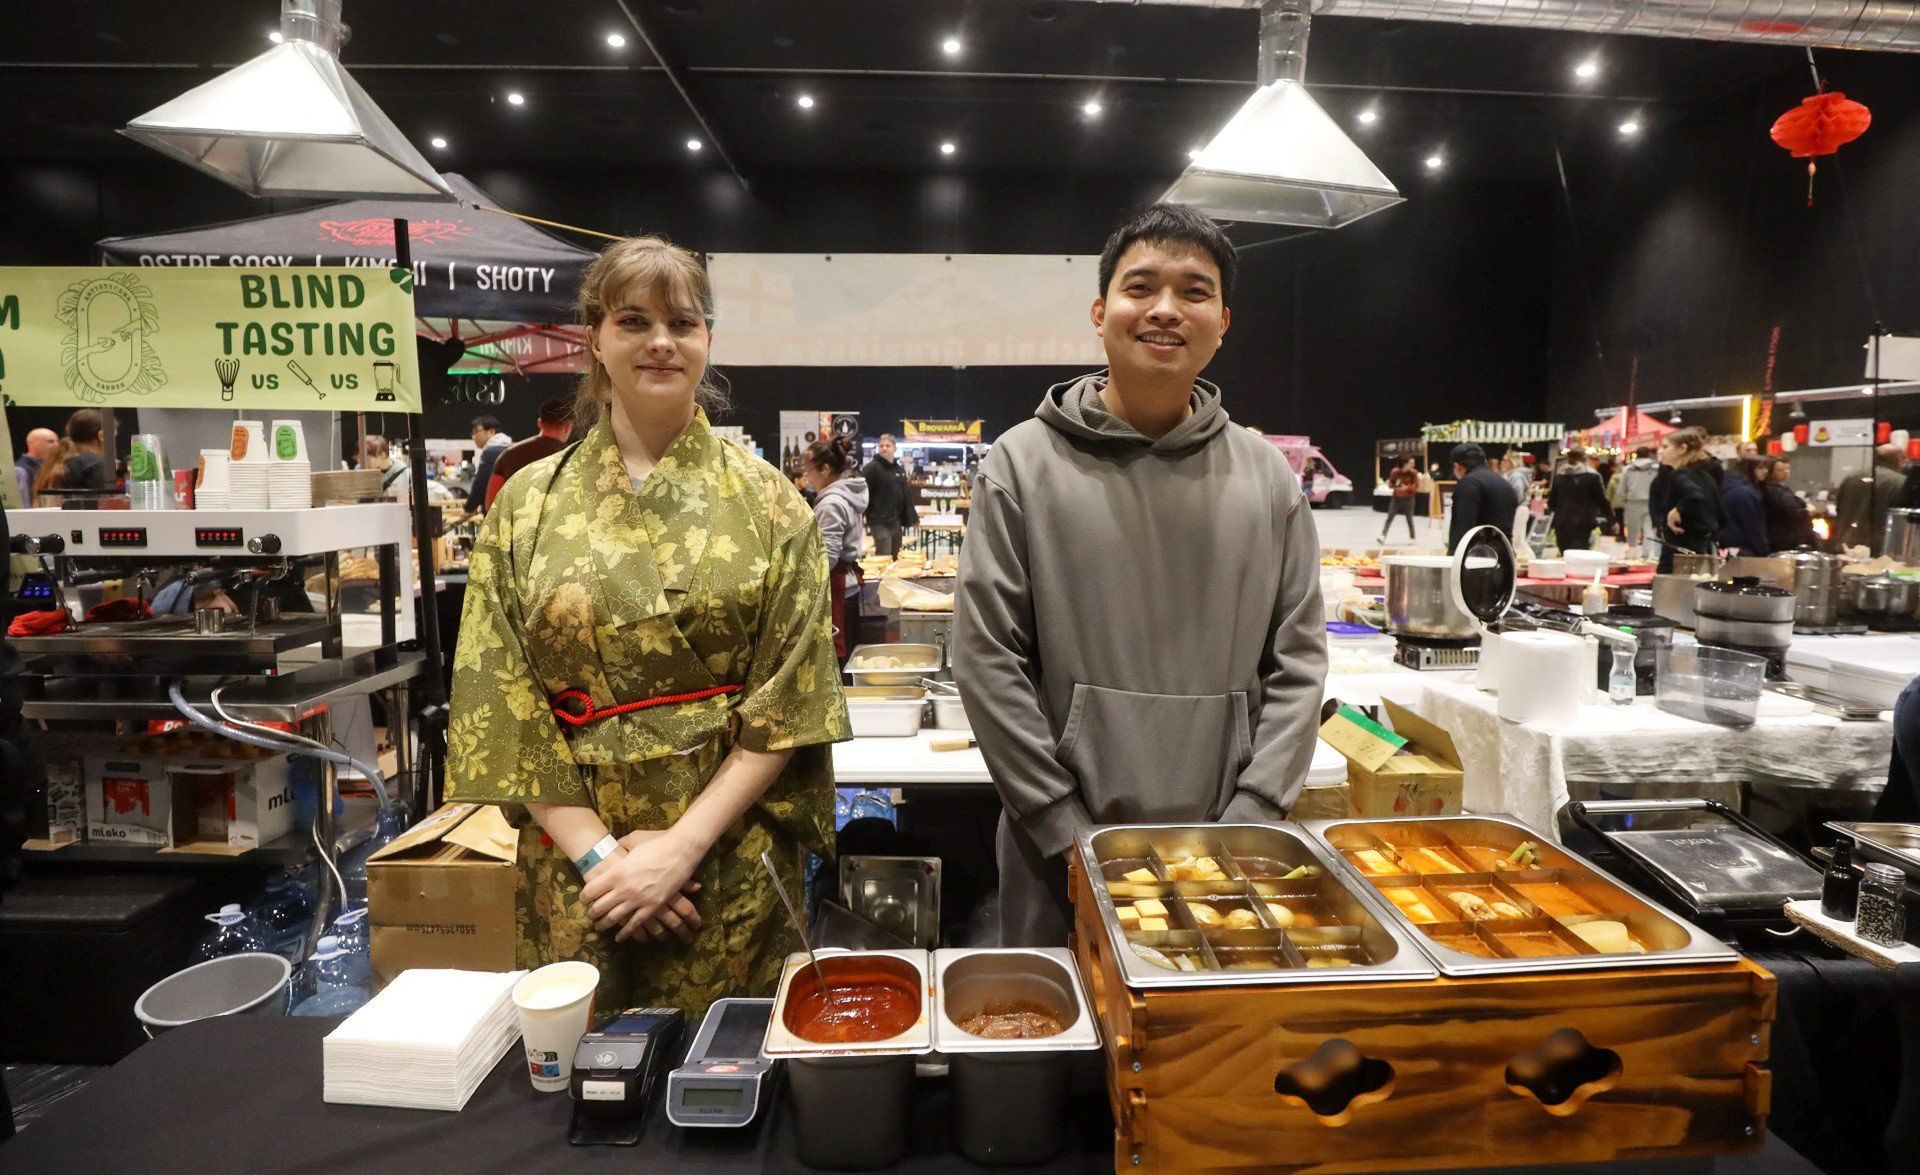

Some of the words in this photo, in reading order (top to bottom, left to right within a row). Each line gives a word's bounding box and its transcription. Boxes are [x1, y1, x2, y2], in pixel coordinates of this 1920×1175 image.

[240, 274, 365, 309] BLIND
[475, 264, 555, 293] SHOTY
[215, 321, 396, 357] TASTING
[91, 828, 127, 839] mleko
